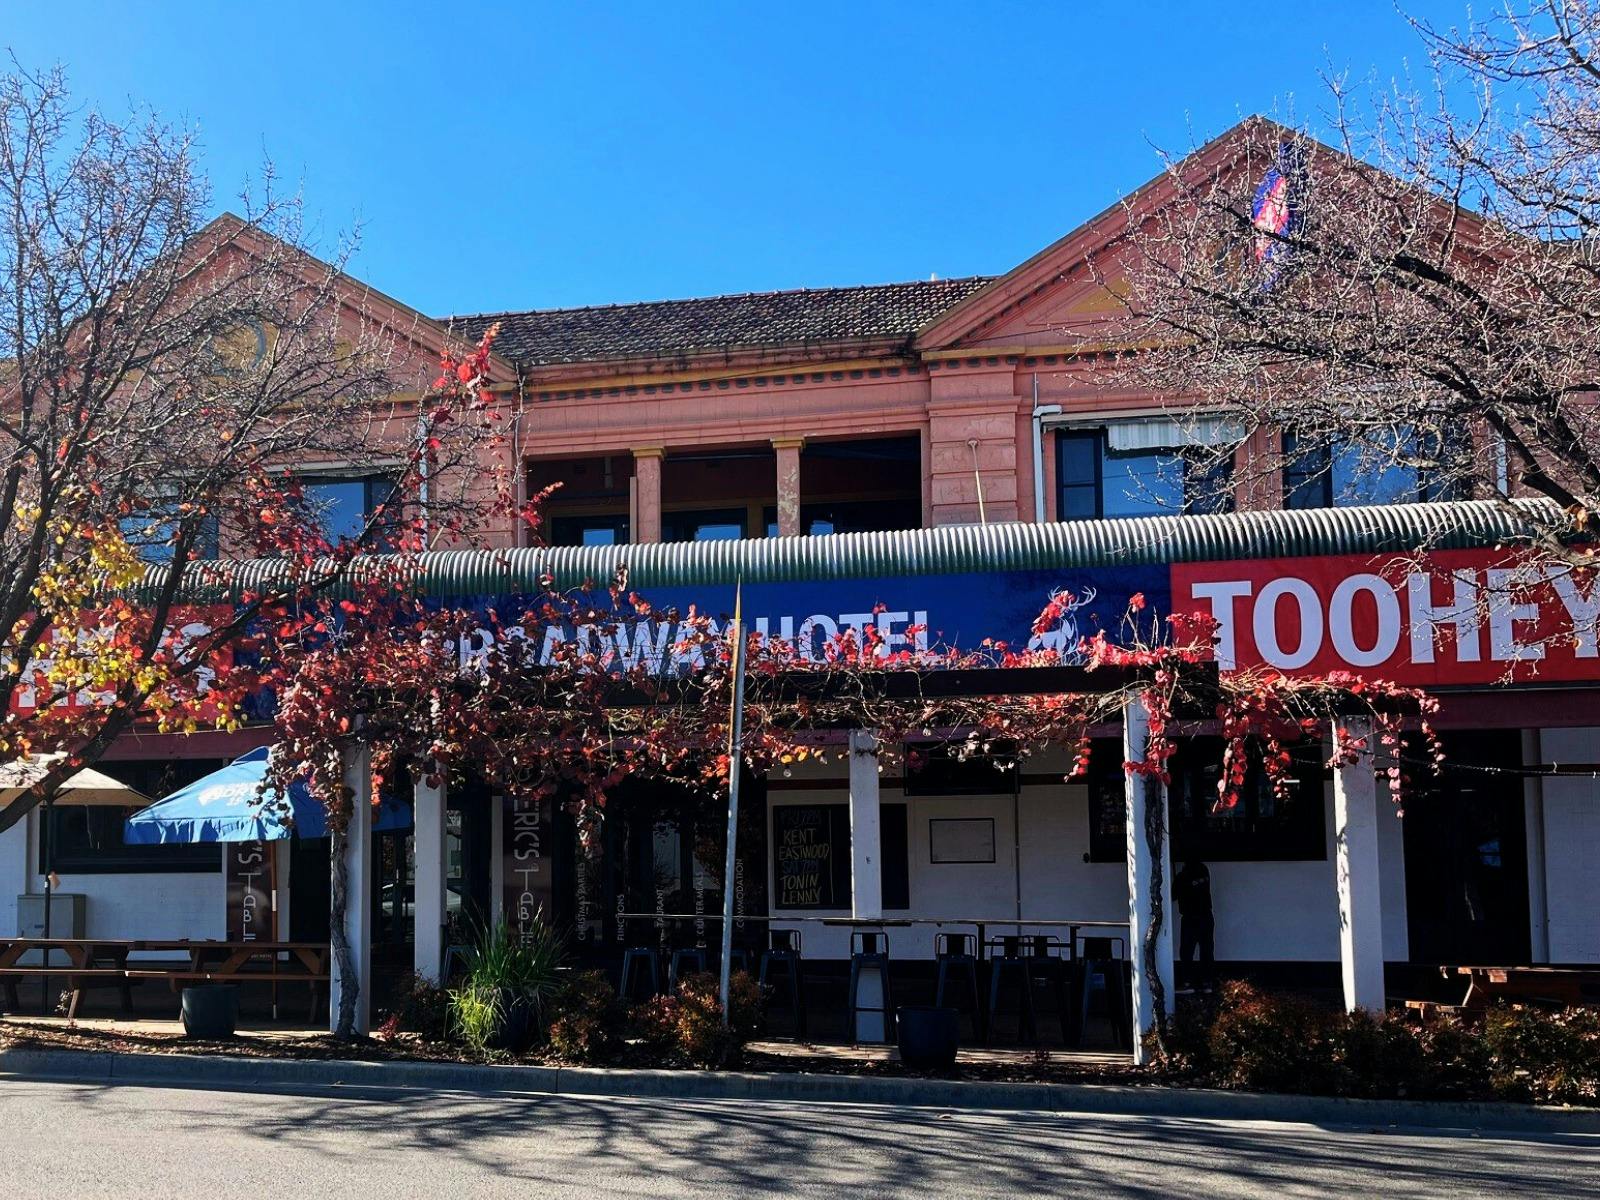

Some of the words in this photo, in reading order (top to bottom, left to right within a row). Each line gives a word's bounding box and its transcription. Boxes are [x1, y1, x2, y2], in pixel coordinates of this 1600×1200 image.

[755, 610, 942, 668] HOTEL
[783, 827, 817, 846] KENT
[778, 843, 830, 861] EASTWOOD
[782, 887, 822, 905] LENNY
[615, 894, 626, 942] FUNCONS
